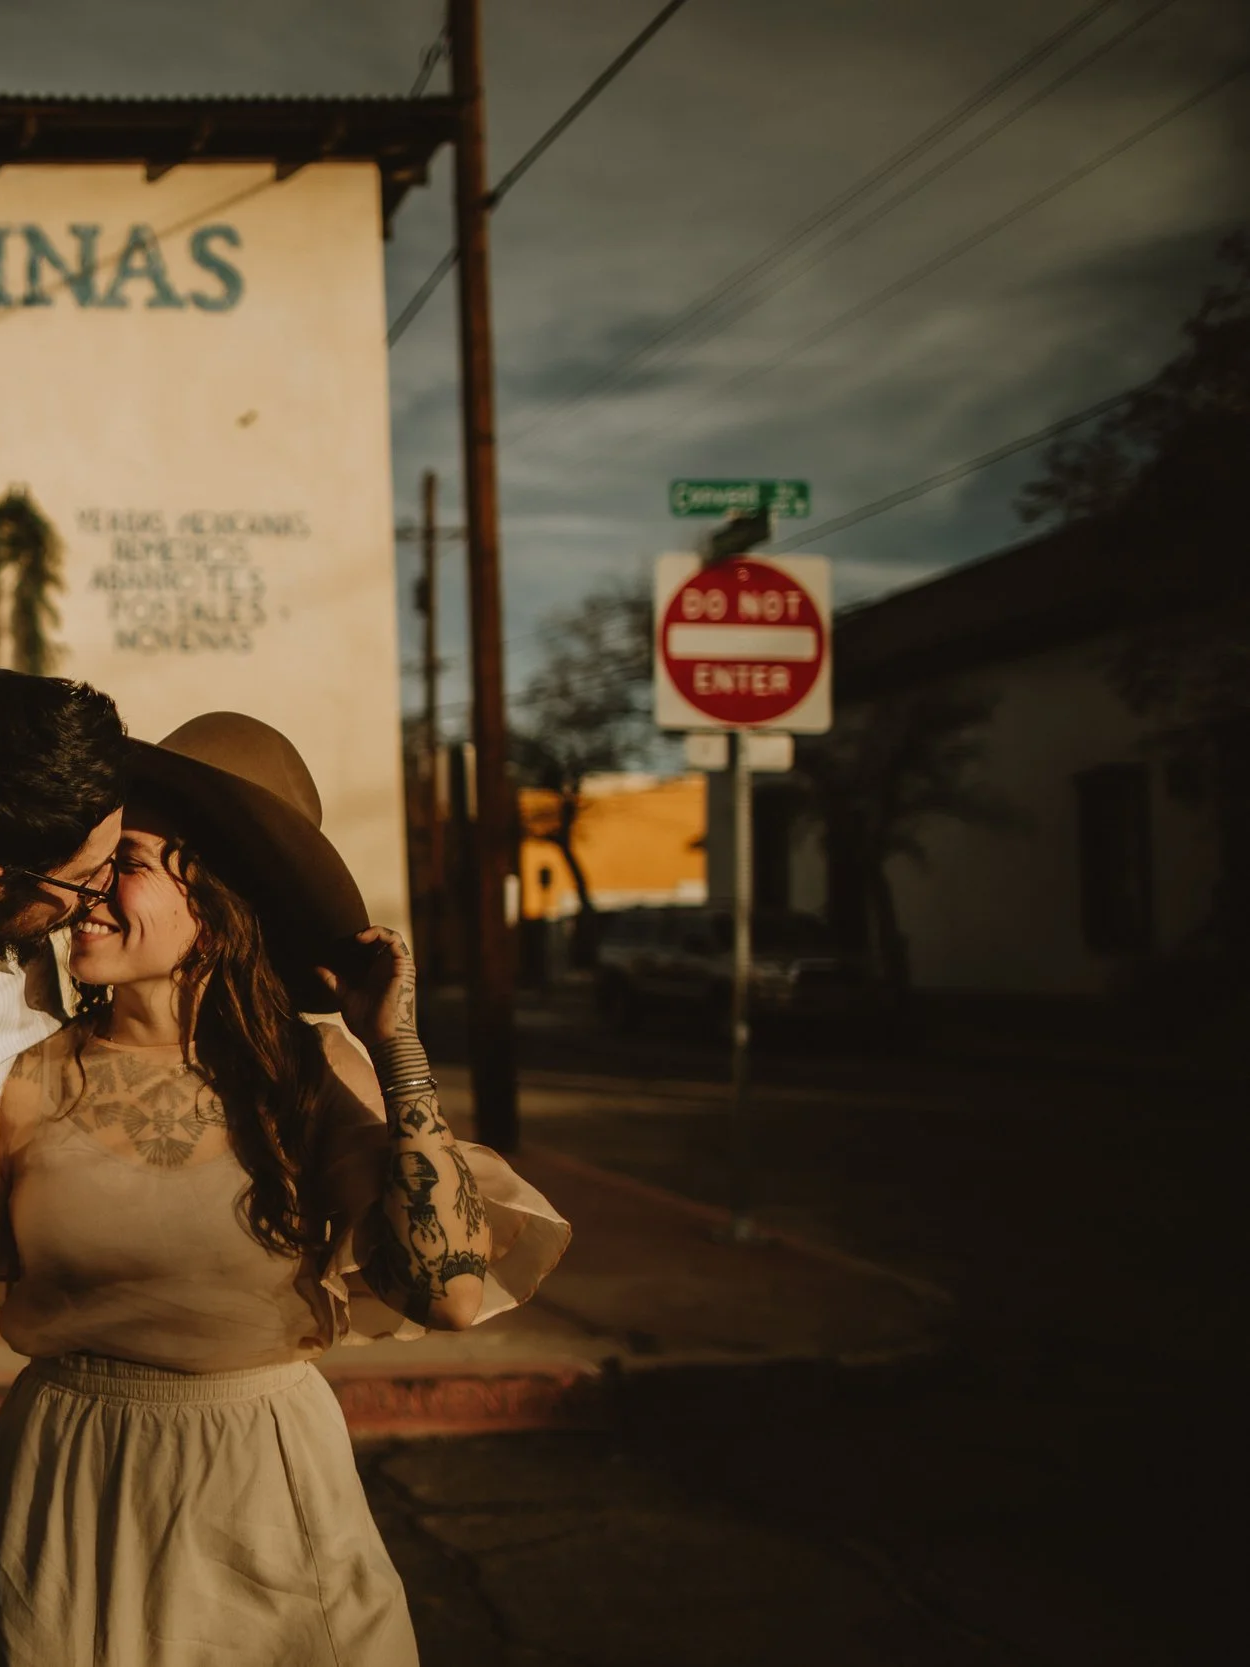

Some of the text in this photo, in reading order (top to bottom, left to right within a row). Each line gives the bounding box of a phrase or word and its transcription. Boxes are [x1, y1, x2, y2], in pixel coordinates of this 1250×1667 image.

[682, 587, 802, 622] DO NOT
[693, 663, 791, 697] ENTER
